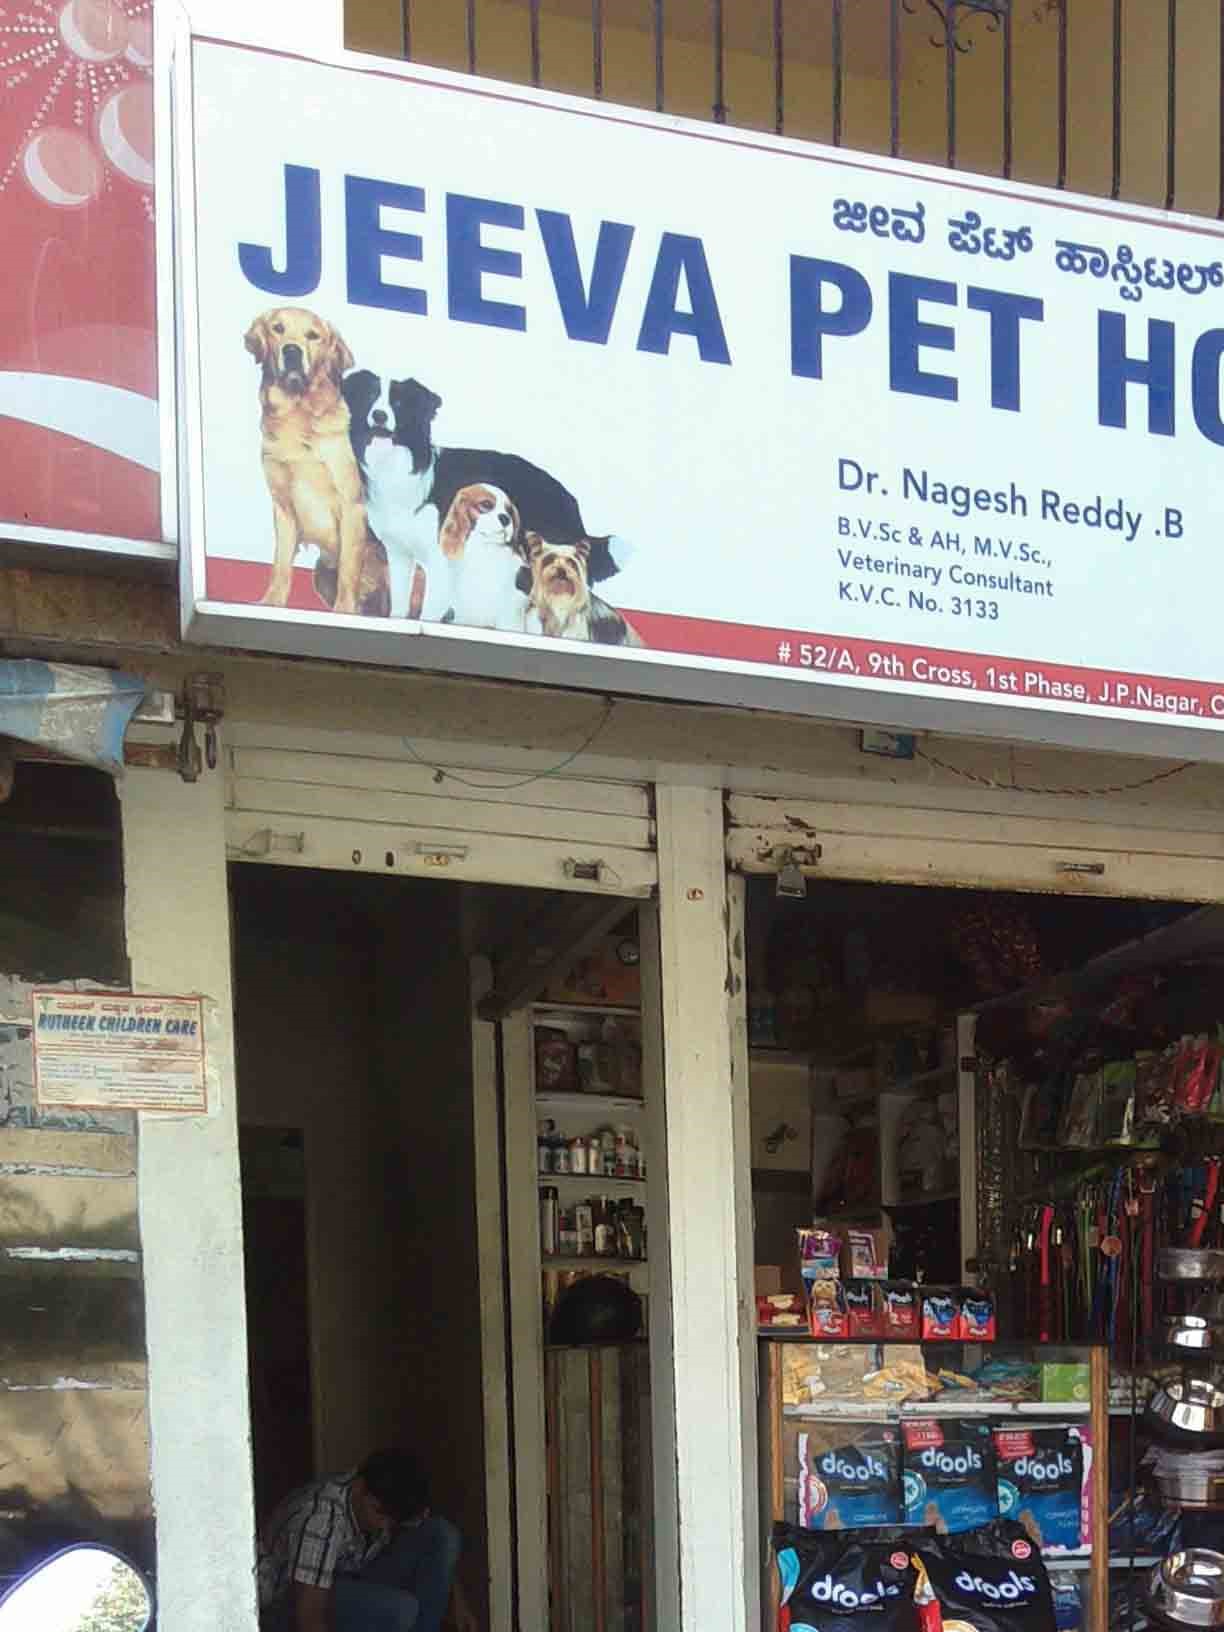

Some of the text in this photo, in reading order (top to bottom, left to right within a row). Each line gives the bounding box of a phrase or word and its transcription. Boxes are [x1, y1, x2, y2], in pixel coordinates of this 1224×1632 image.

[832, 198, 1224, 302] ಜೀವ ಪೆಟ್ ಹಾಸ್ಪಿಟಲ್
[237, 163, 732, 366] JEEVA
[789, 253, 1044, 413] PET
[838, 458, 888, 496] Dr.
[902, 467, 1028, 517] Nagesh
[1041, 488, 1142, 542] Reddy
[838, 516, 1052, 568] B.V.Sc & AH, M.V.Sc.,
[838, 549, 1055, 597] Veterinary Consultant
[839, 581, 1000, 620] K.V.C. No. 3133
[778, 642, 791, 663] #
[800, 644, 861, 674] 52/A,
[868, 652, 905, 676] 9th
[912, 658, 977, 688] Cross,
[985, 667, 1018, 691] 1st
[1025, 671, 1091, 703] Phase,
[1098, 681, 1204, 716] J.P.Nagar,
[99, 1015, 162, 1033] CHILDREN
[165, 1019, 199, 1036] CARE
[822, 1451, 883, 1480] drools
[921, 1447, 982, 1473] drools
[1014, 1453, 1073, 1479] drools
[955, 1571, 1031, 1600] drools
